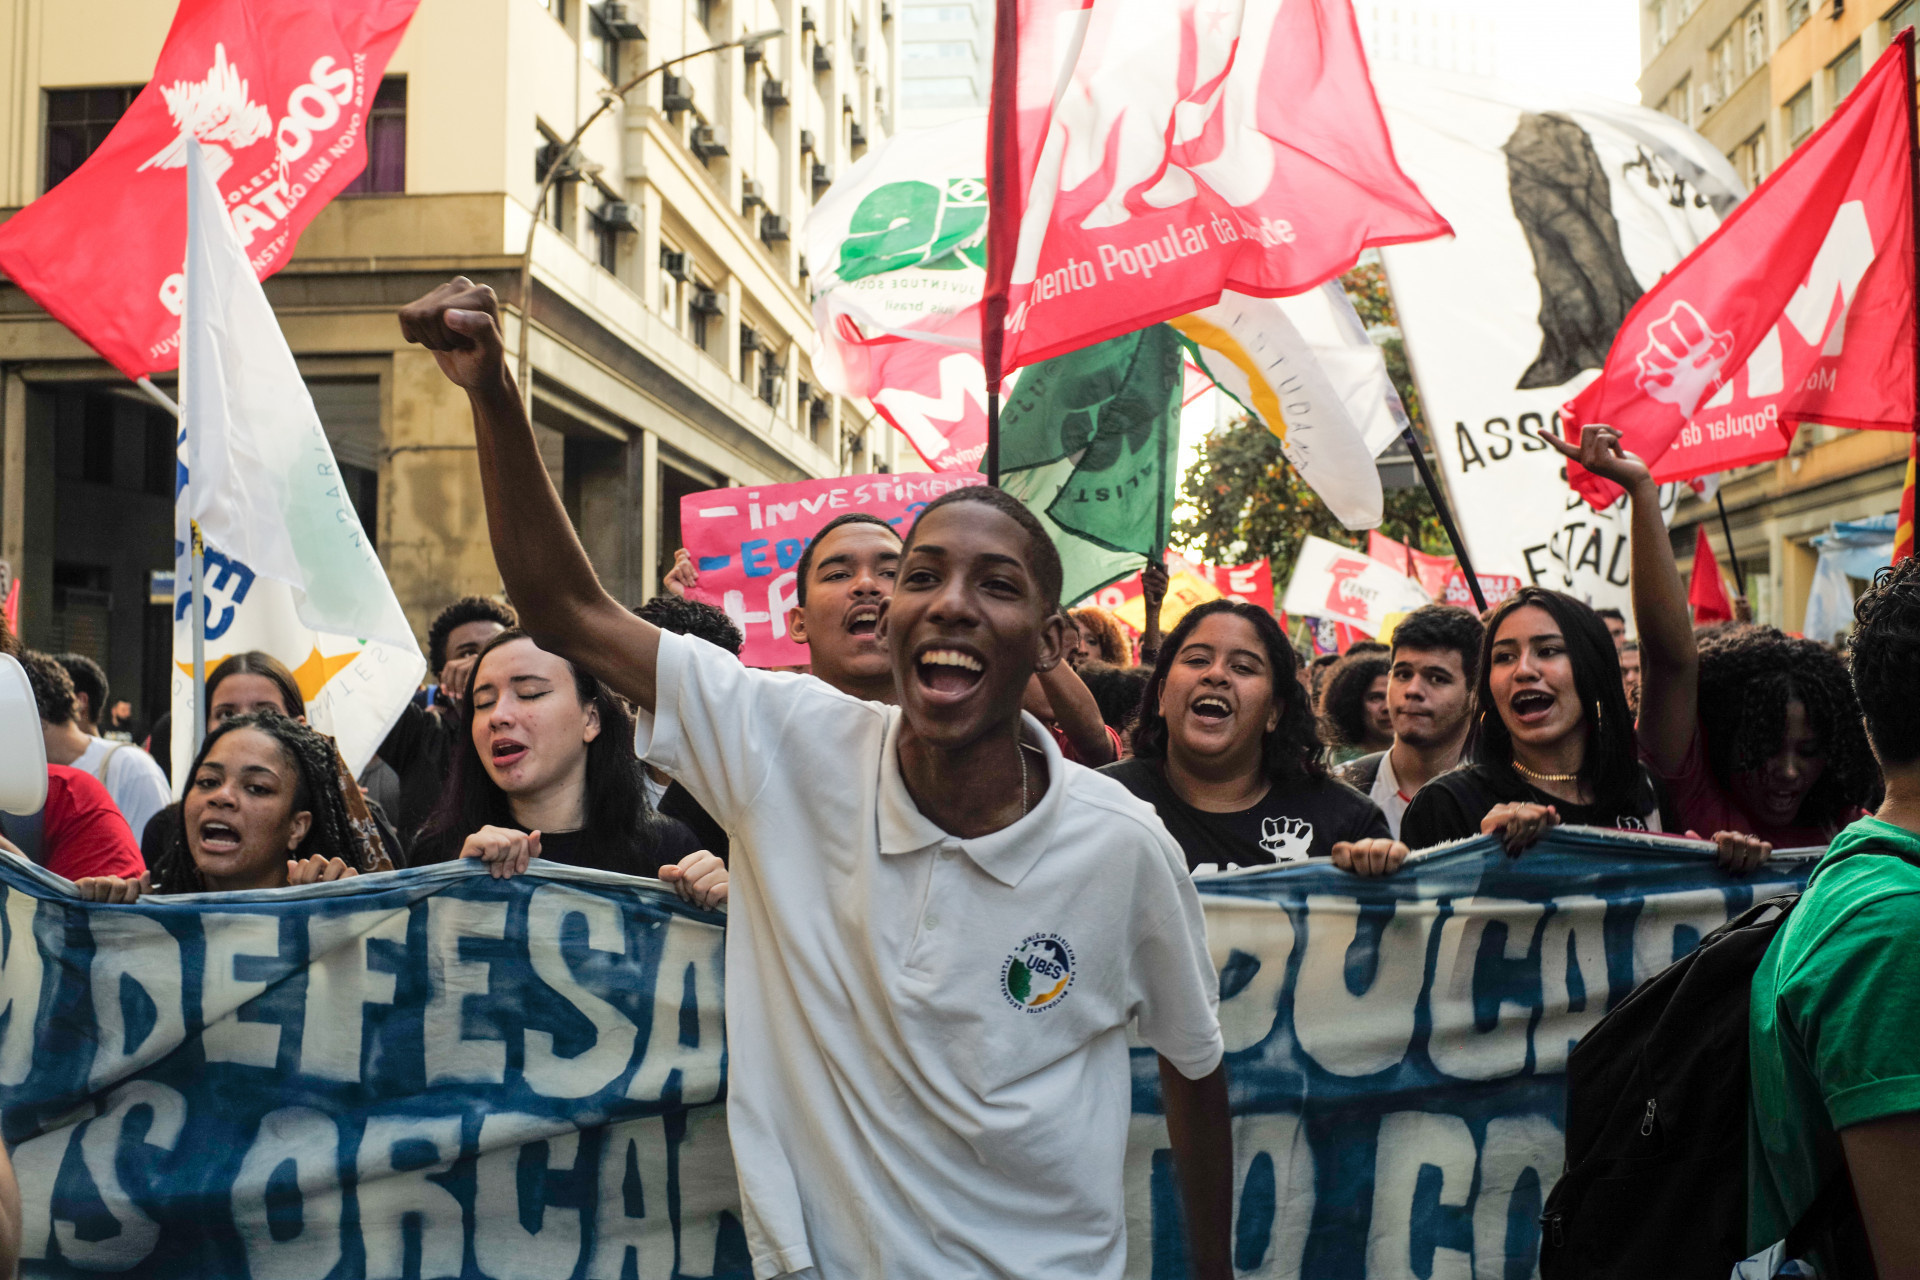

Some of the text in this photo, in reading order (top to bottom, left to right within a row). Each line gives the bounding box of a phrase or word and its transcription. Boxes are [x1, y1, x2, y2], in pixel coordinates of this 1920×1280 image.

[303, 156, 333, 184] UM
[1097, 223, 1209, 281] Popular
[1211, 211, 1239, 245] da
[1026, 953, 1062, 980] UBES
[87, 884, 727, 1102] DEFESA
